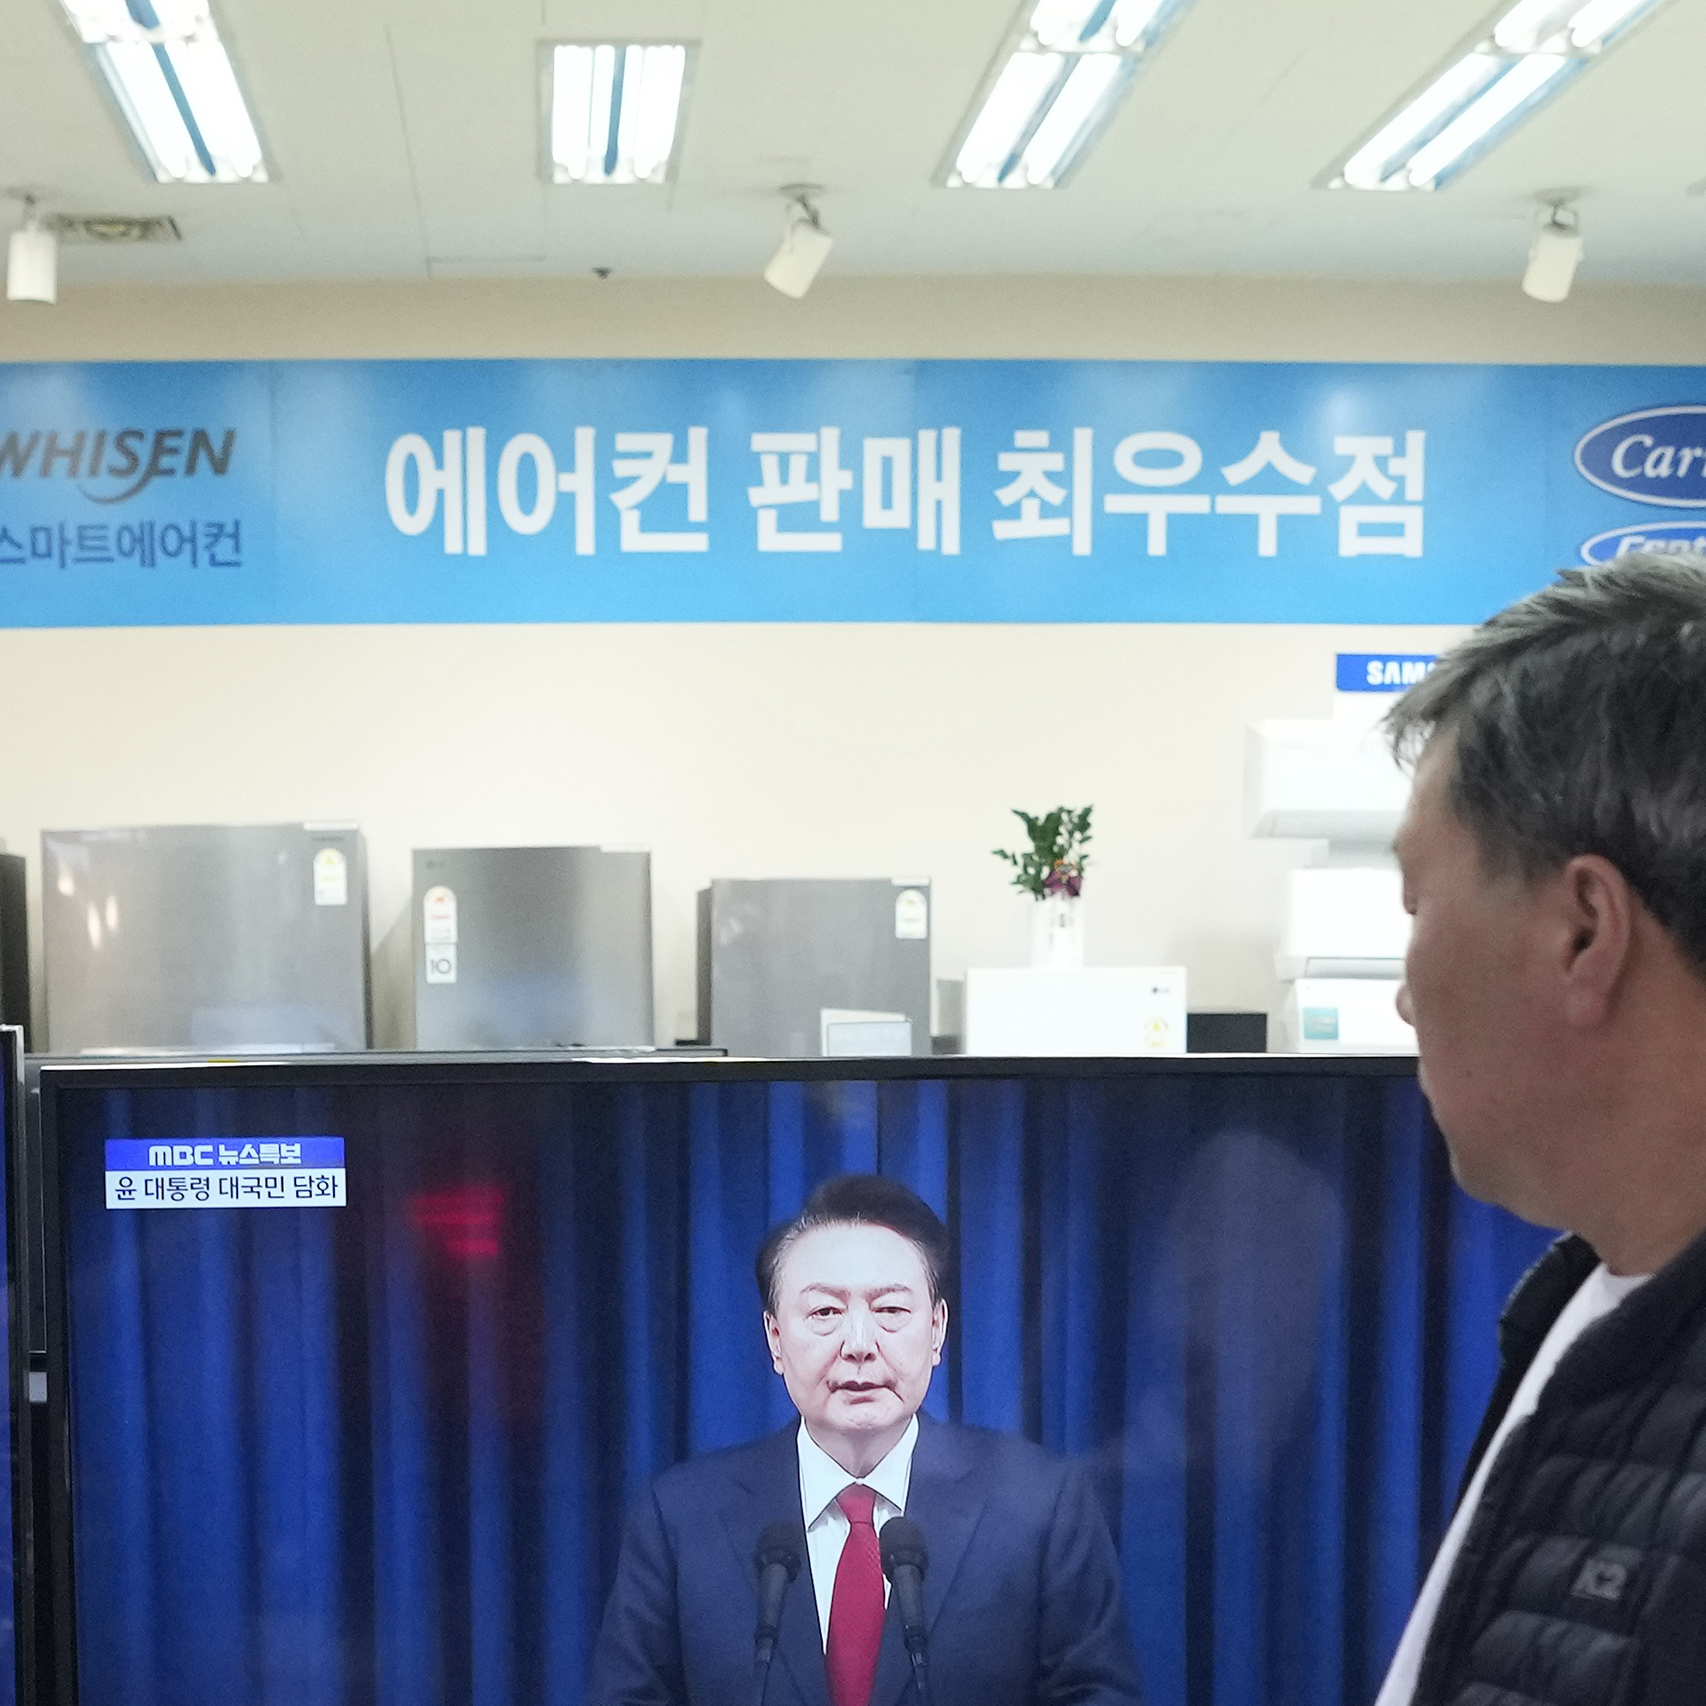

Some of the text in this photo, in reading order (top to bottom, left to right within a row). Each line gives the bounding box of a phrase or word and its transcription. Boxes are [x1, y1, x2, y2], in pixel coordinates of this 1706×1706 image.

[384, 426, 1429, 558] 에어컨 판매 최우수점
[149, 1144, 301, 1166] MBC 뉴스특보
[115, 1175, 338, 1201] 윤 대통령 대국민 담화
